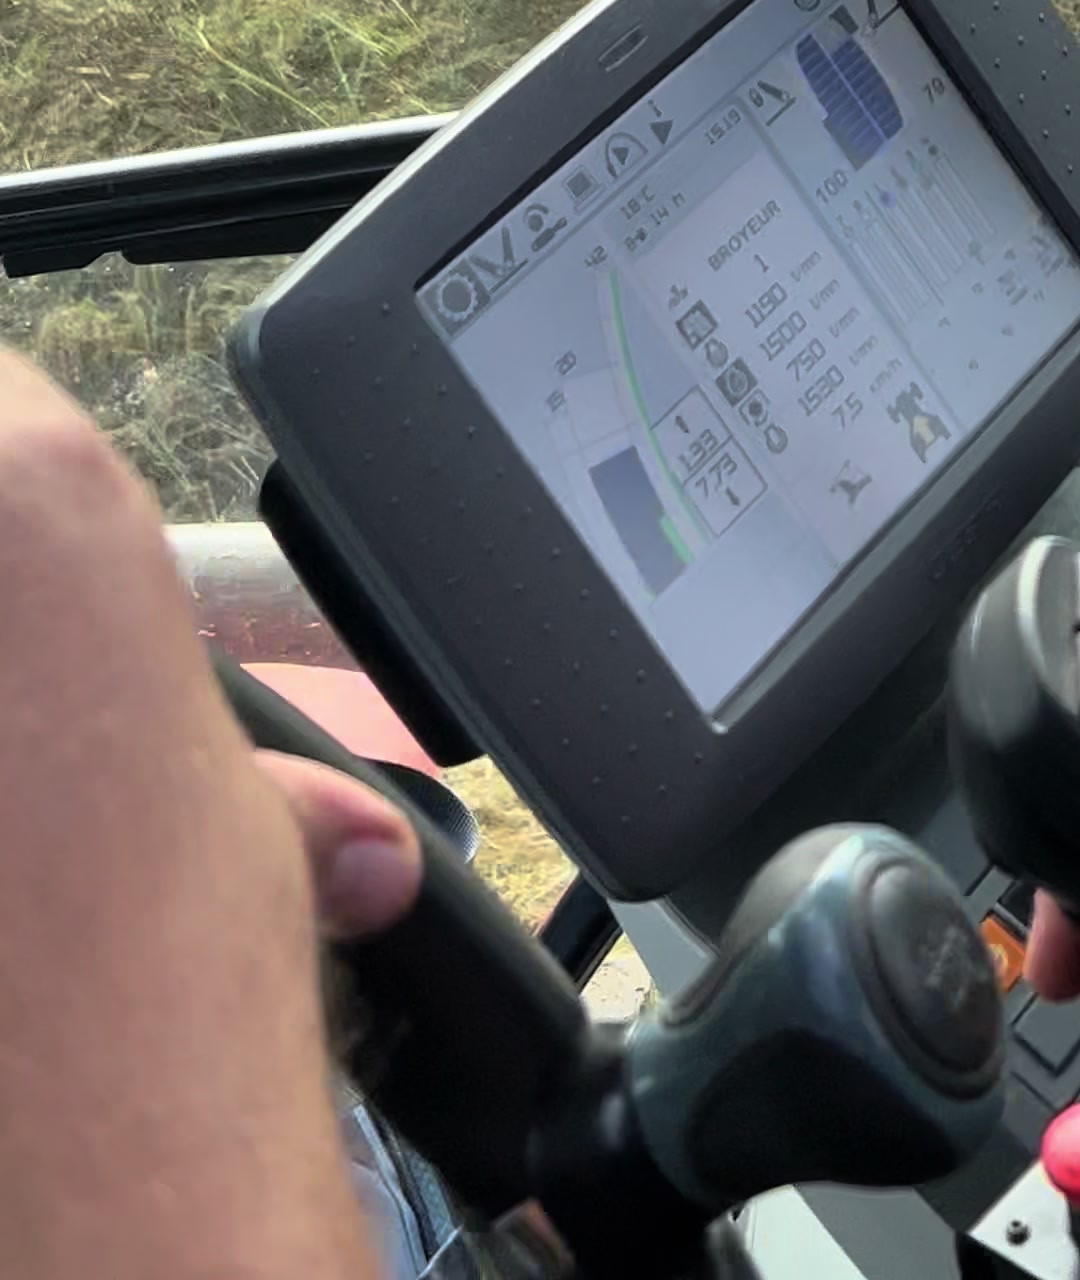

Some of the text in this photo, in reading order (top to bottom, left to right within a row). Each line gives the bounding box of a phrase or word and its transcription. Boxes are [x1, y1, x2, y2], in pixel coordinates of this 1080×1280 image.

[814, 167, 850, 205] 100
[706, 198, 781, 272] BROYEUR
[743, 281, 788, 328] 1190
[758, 309, 808, 361] 1500
[784, 337, 827, 382] 750
[797, 363, 846, 416] 1530
